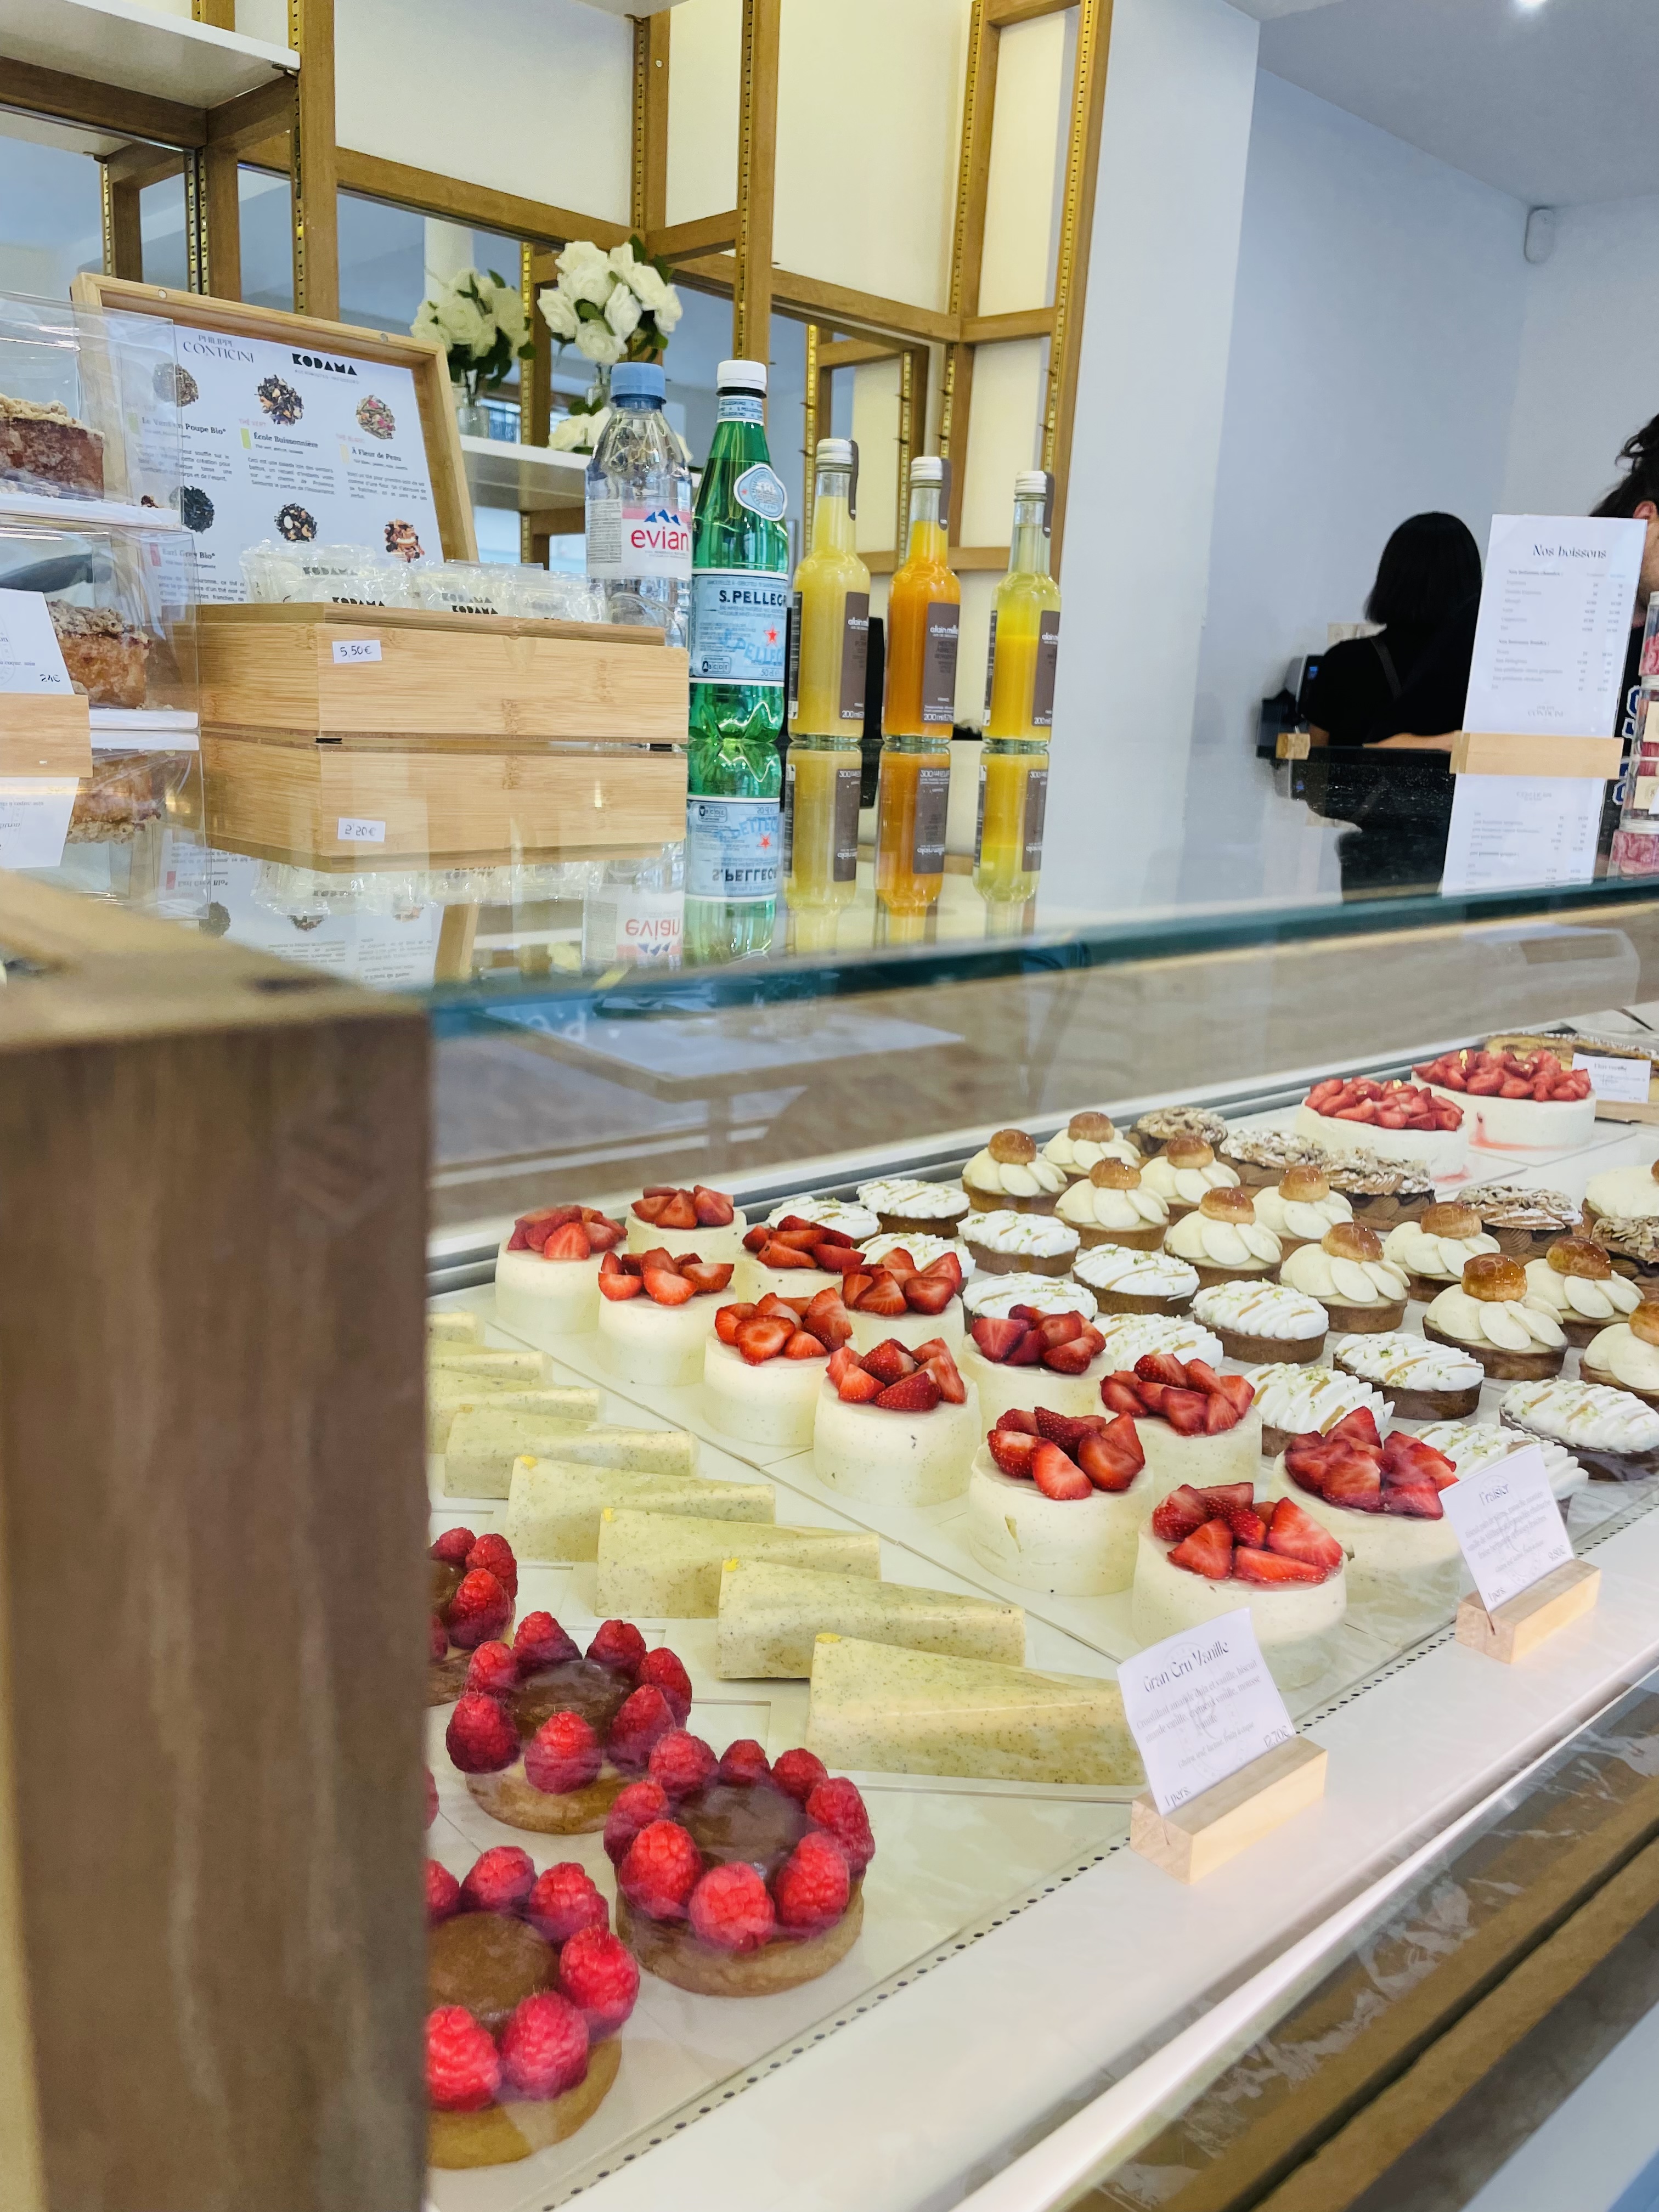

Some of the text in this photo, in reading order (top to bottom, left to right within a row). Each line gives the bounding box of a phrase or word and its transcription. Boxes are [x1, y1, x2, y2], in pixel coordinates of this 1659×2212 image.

[183, 341, 254, 363] CONTICINI
[292, 353, 358, 376] KODAMA
[185, 423, 209, 433] Poupe
[253, 431, 273, 442] École
[630, 526, 690, 552] evian
[1532, 544, 1607, 560] Nos boissons
[340, 645, 373, 658] 5,50€
[1479, 1483, 1509, 1506] Fraisier
[1143, 1640, 1229, 1693] Gran Cru Vanille
[1136, 1705, 1170, 1730] Croustillant
[1235, 1659, 1259, 1675] biscuit
